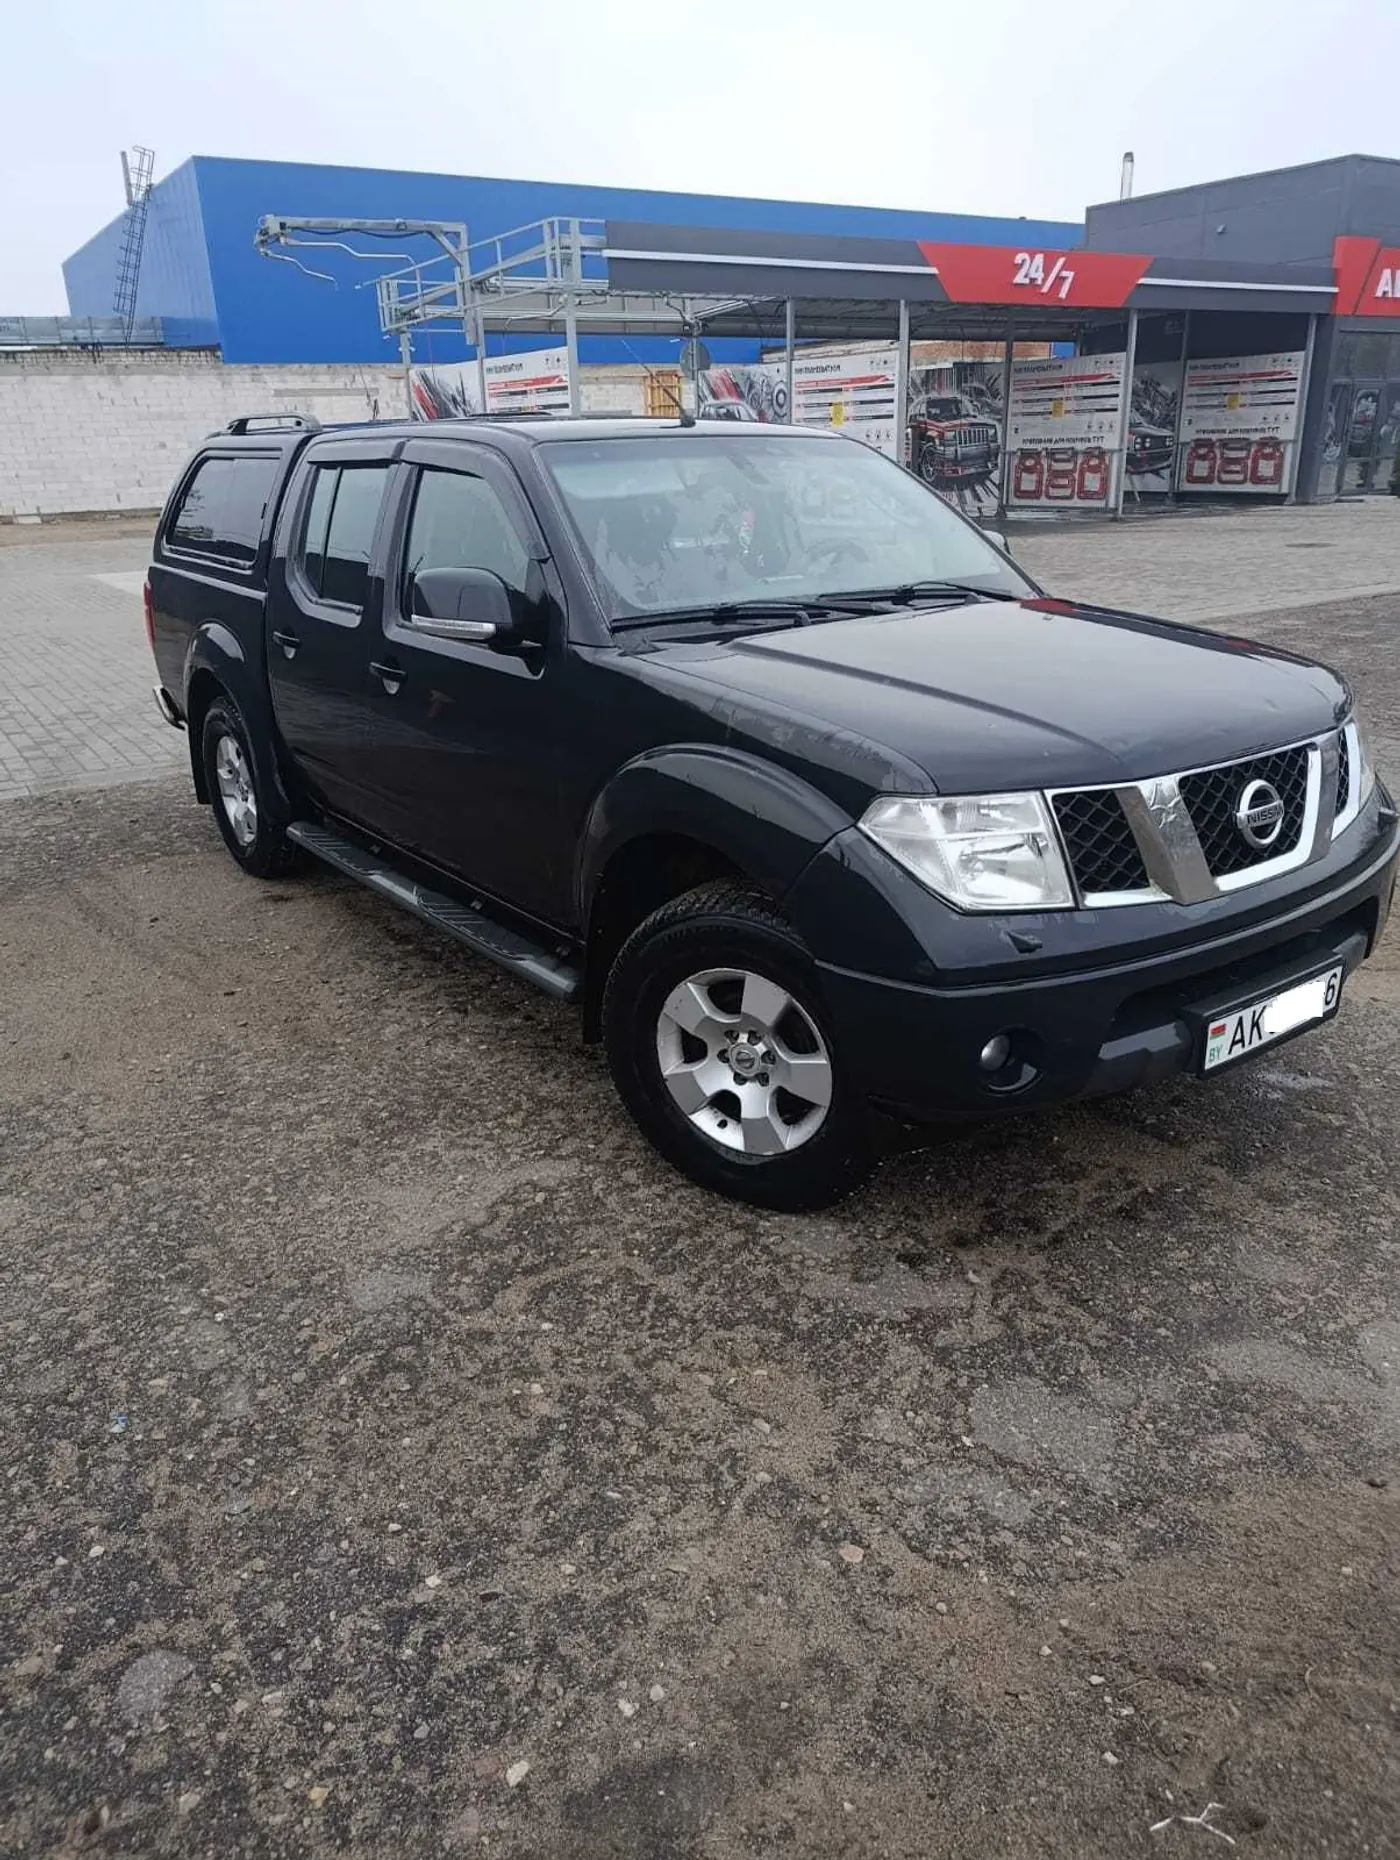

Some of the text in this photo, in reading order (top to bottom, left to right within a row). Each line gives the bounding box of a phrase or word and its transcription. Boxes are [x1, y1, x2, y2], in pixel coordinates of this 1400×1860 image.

[1013, 252, 1075, 300] 24/7
[1092, 435, 1105, 443] ТУТ
[1209, 1043, 1224, 1062] BY
